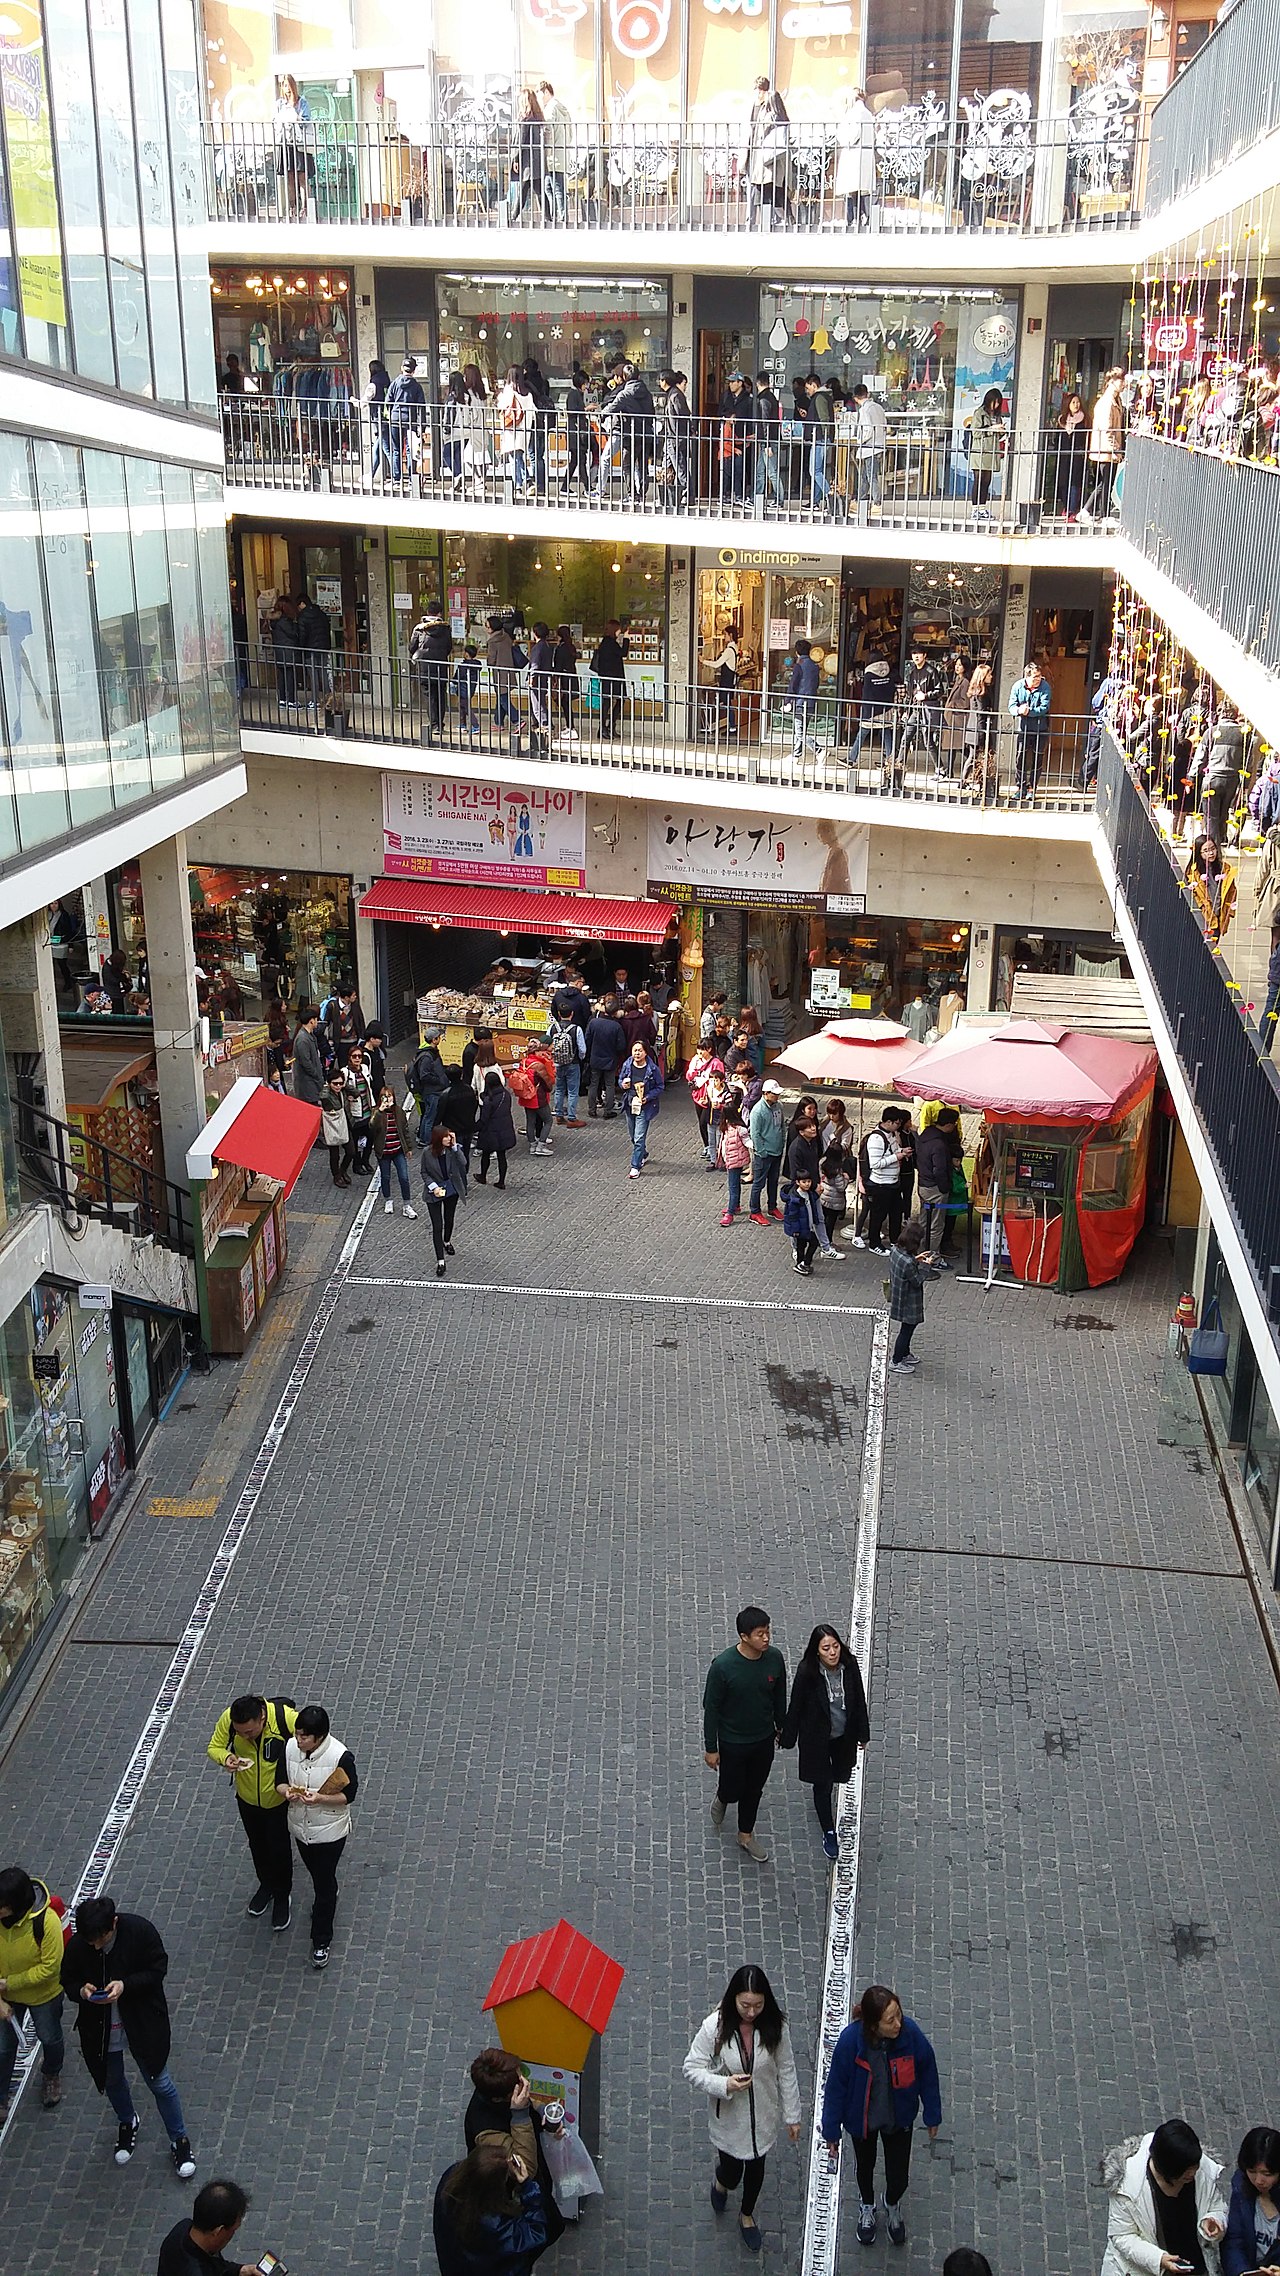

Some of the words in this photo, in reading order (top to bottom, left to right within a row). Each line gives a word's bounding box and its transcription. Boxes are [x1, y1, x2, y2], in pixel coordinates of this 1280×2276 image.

[740, 550, 800, 567] indimap
[437, 783, 501, 811] 시간의
[530, 789, 574, 815] 나이
